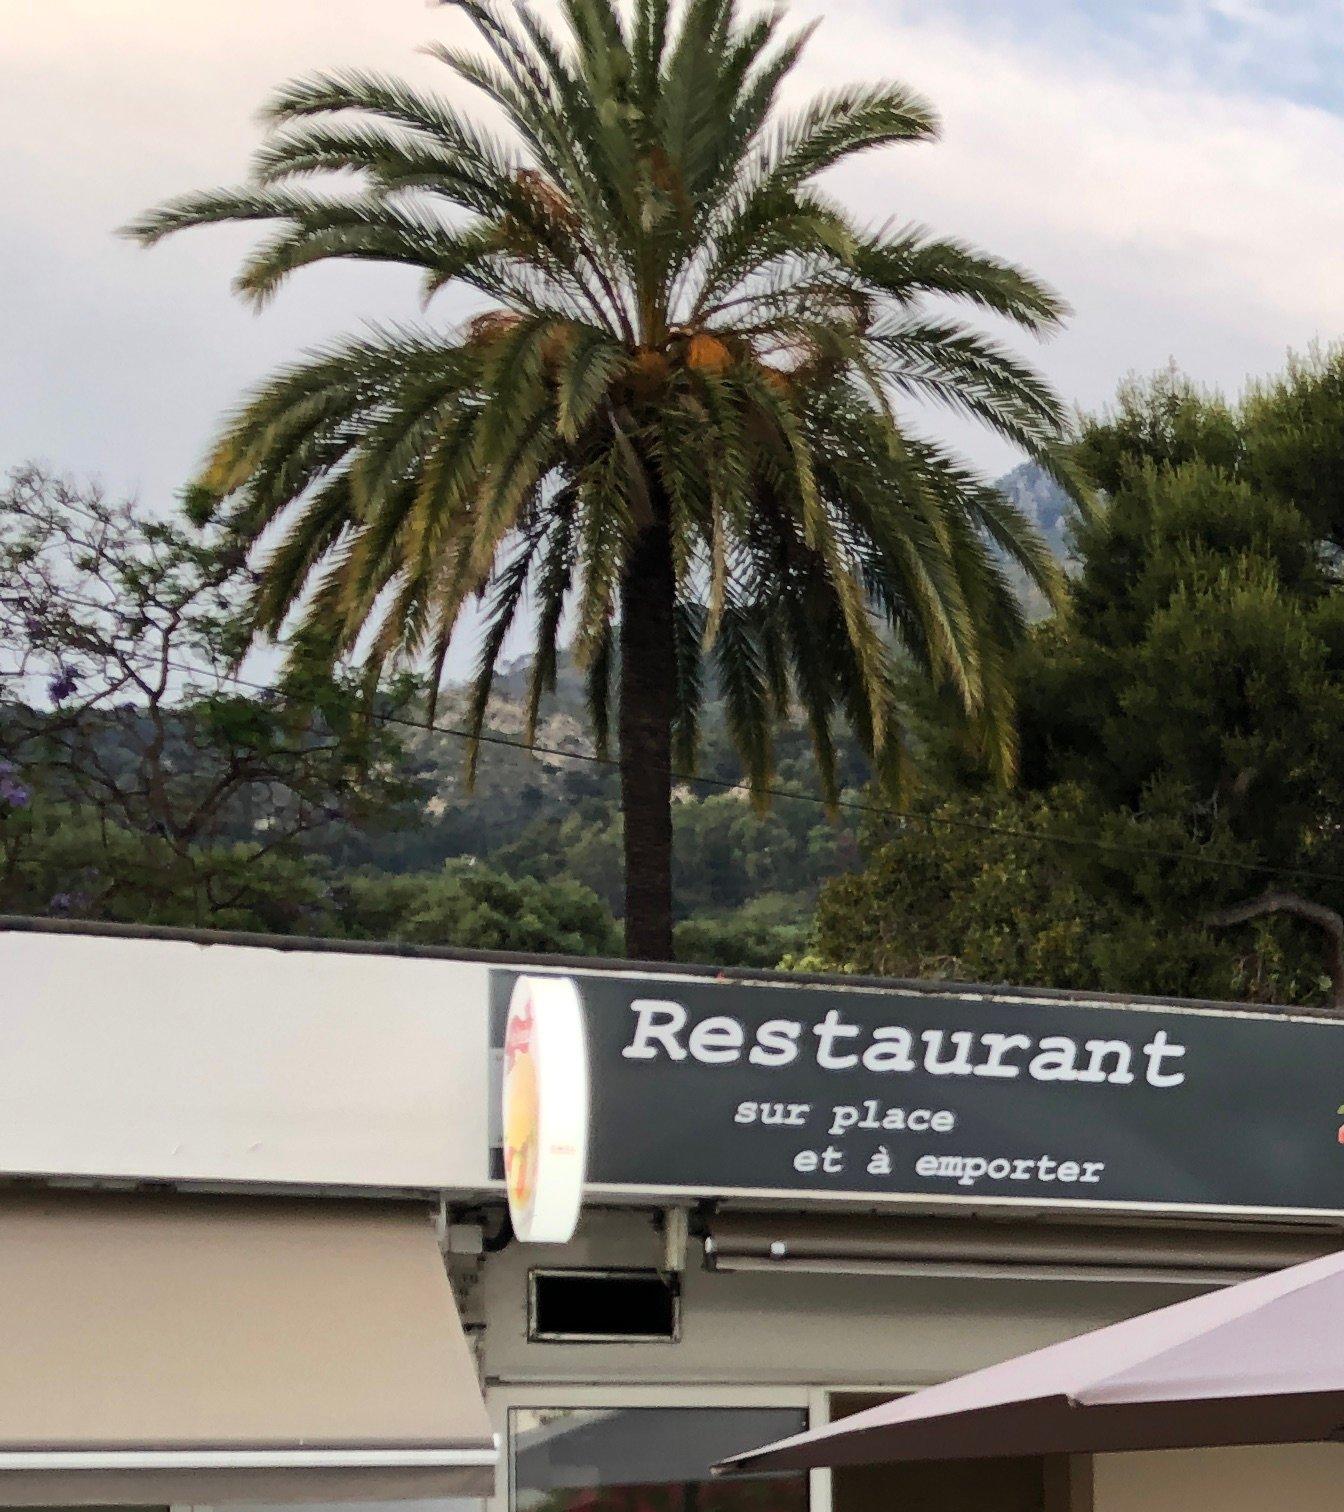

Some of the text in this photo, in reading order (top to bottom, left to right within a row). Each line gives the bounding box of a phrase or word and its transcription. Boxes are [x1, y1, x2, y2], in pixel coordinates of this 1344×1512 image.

[620, 998, 1187, 1088] Restaurant
[734, 1099, 956, 1135] sur place
[793, 1145, 1106, 1186] et à emporter
